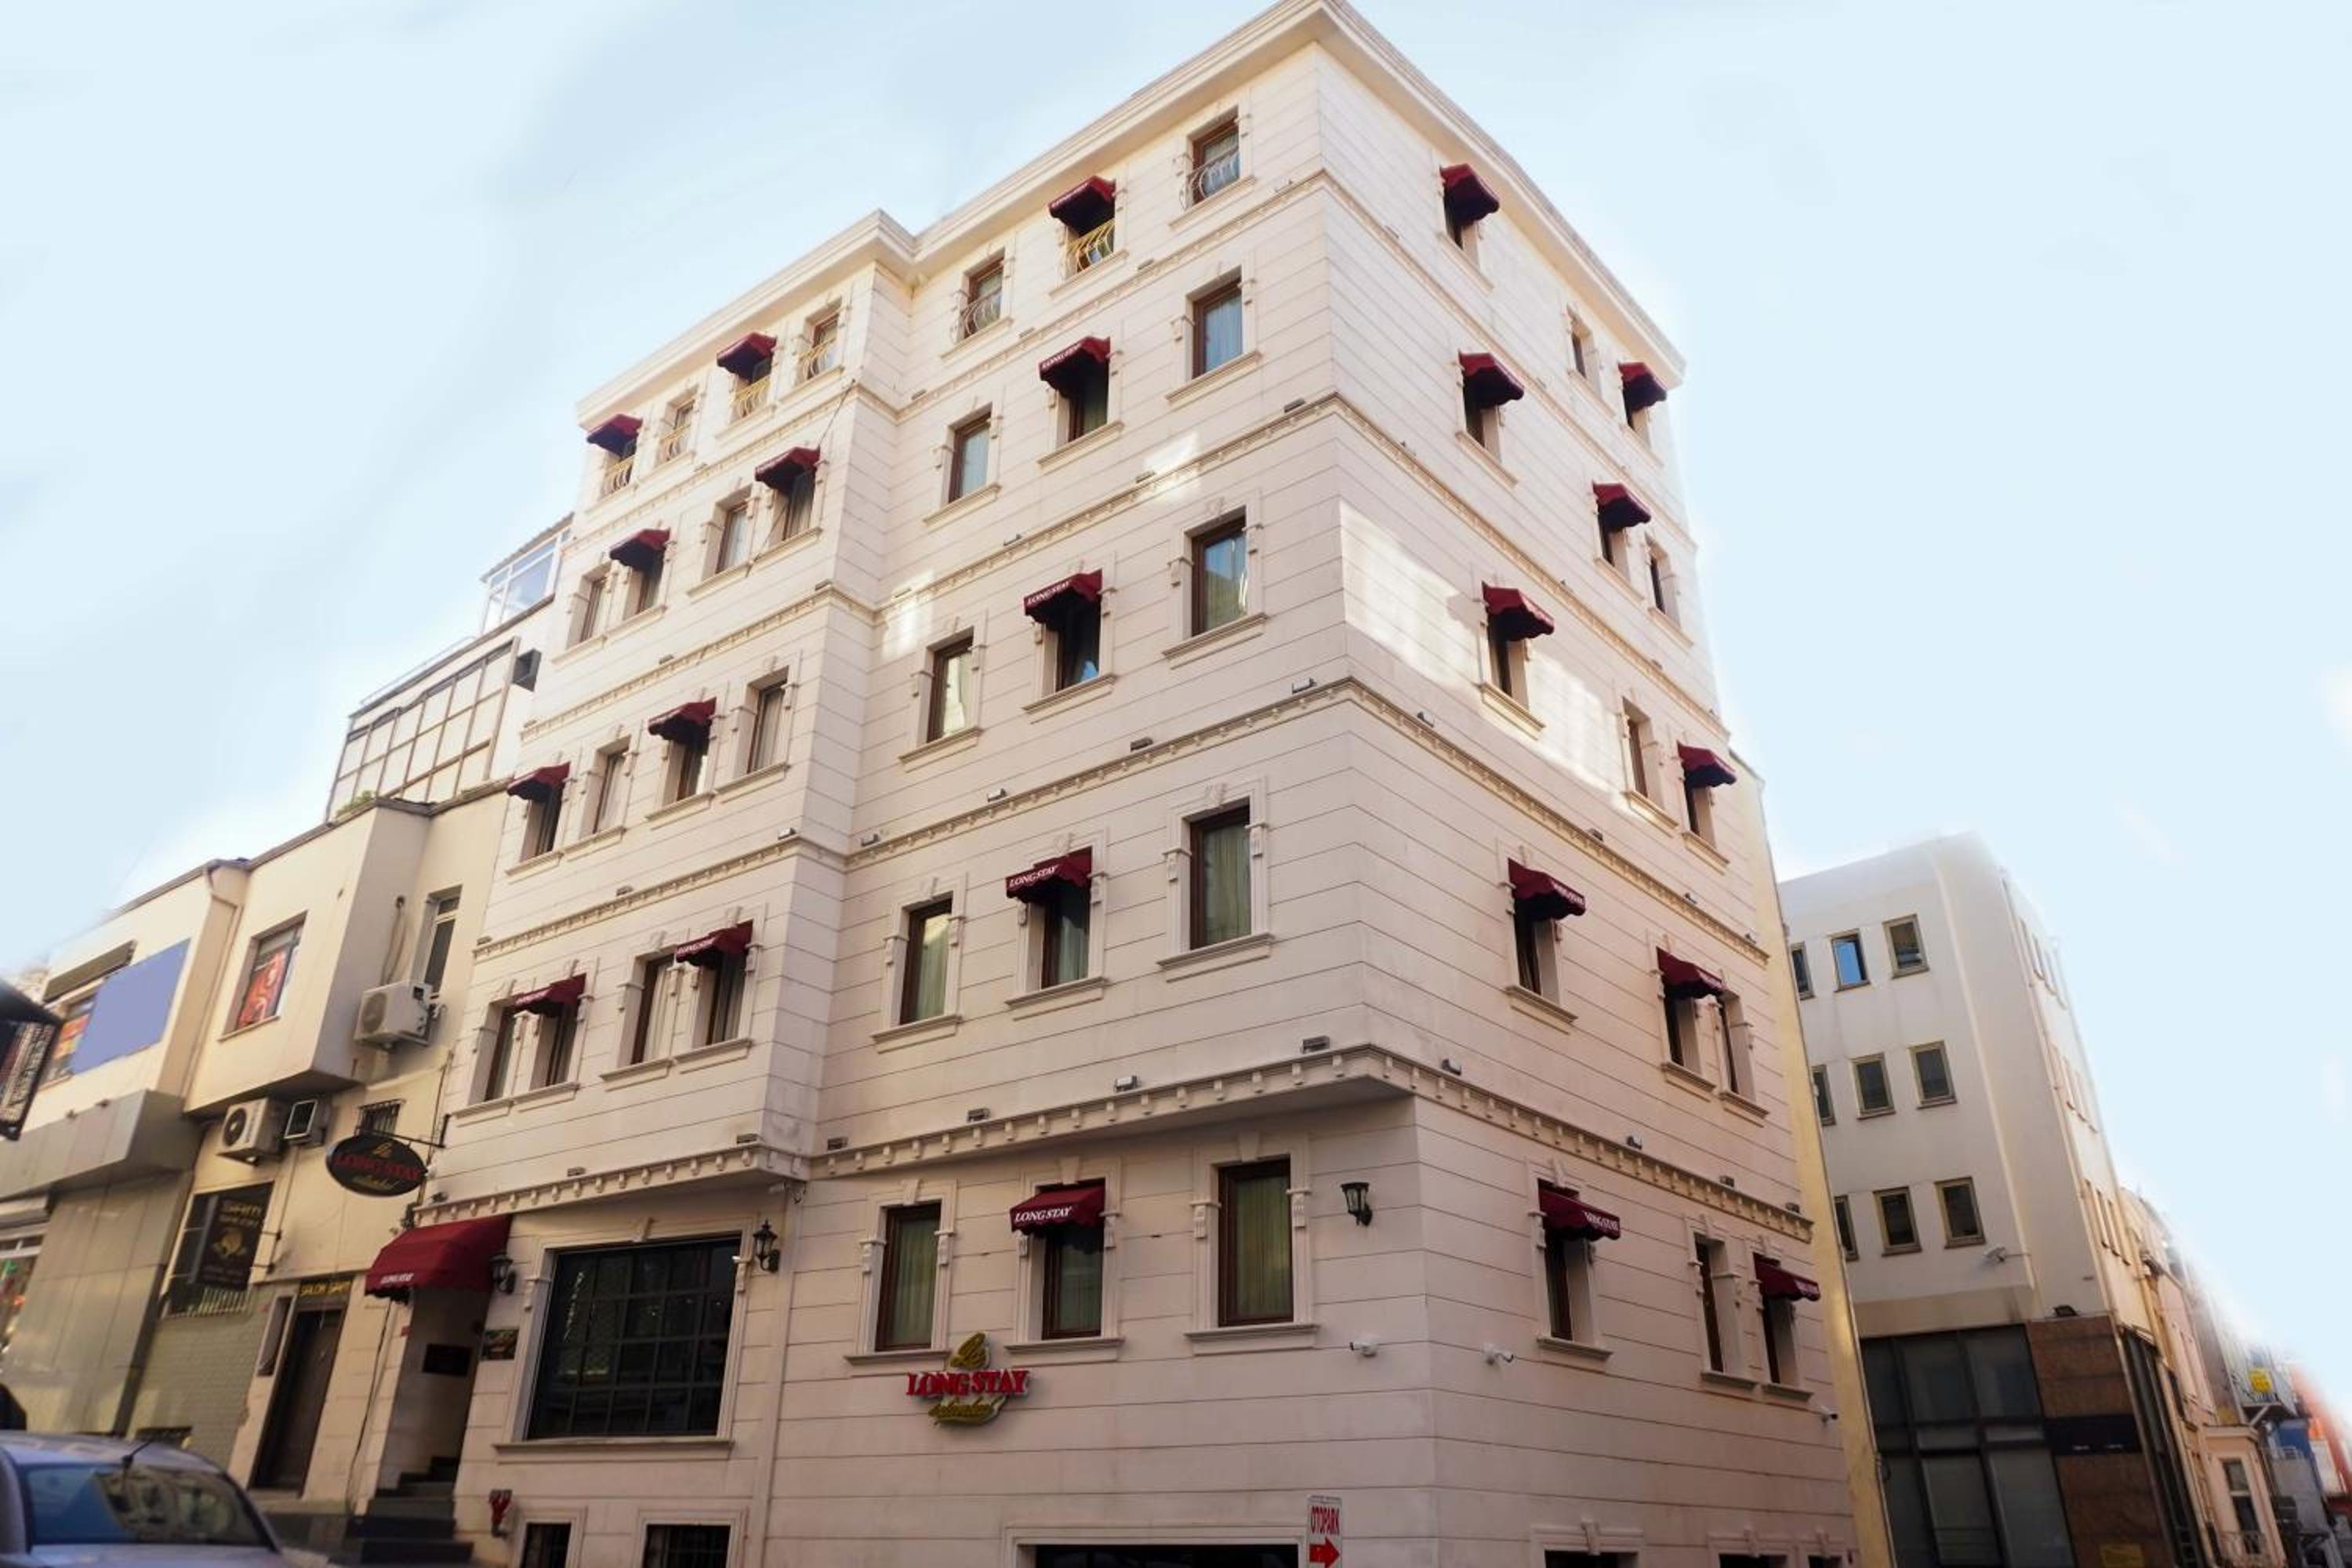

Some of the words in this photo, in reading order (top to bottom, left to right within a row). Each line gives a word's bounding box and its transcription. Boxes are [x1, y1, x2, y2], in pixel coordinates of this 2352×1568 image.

[906, 1371, 970, 1396] LONG
[971, 1368, 1029, 1393] STAY
[1310, 1505, 1340, 1535] OTOPARK
